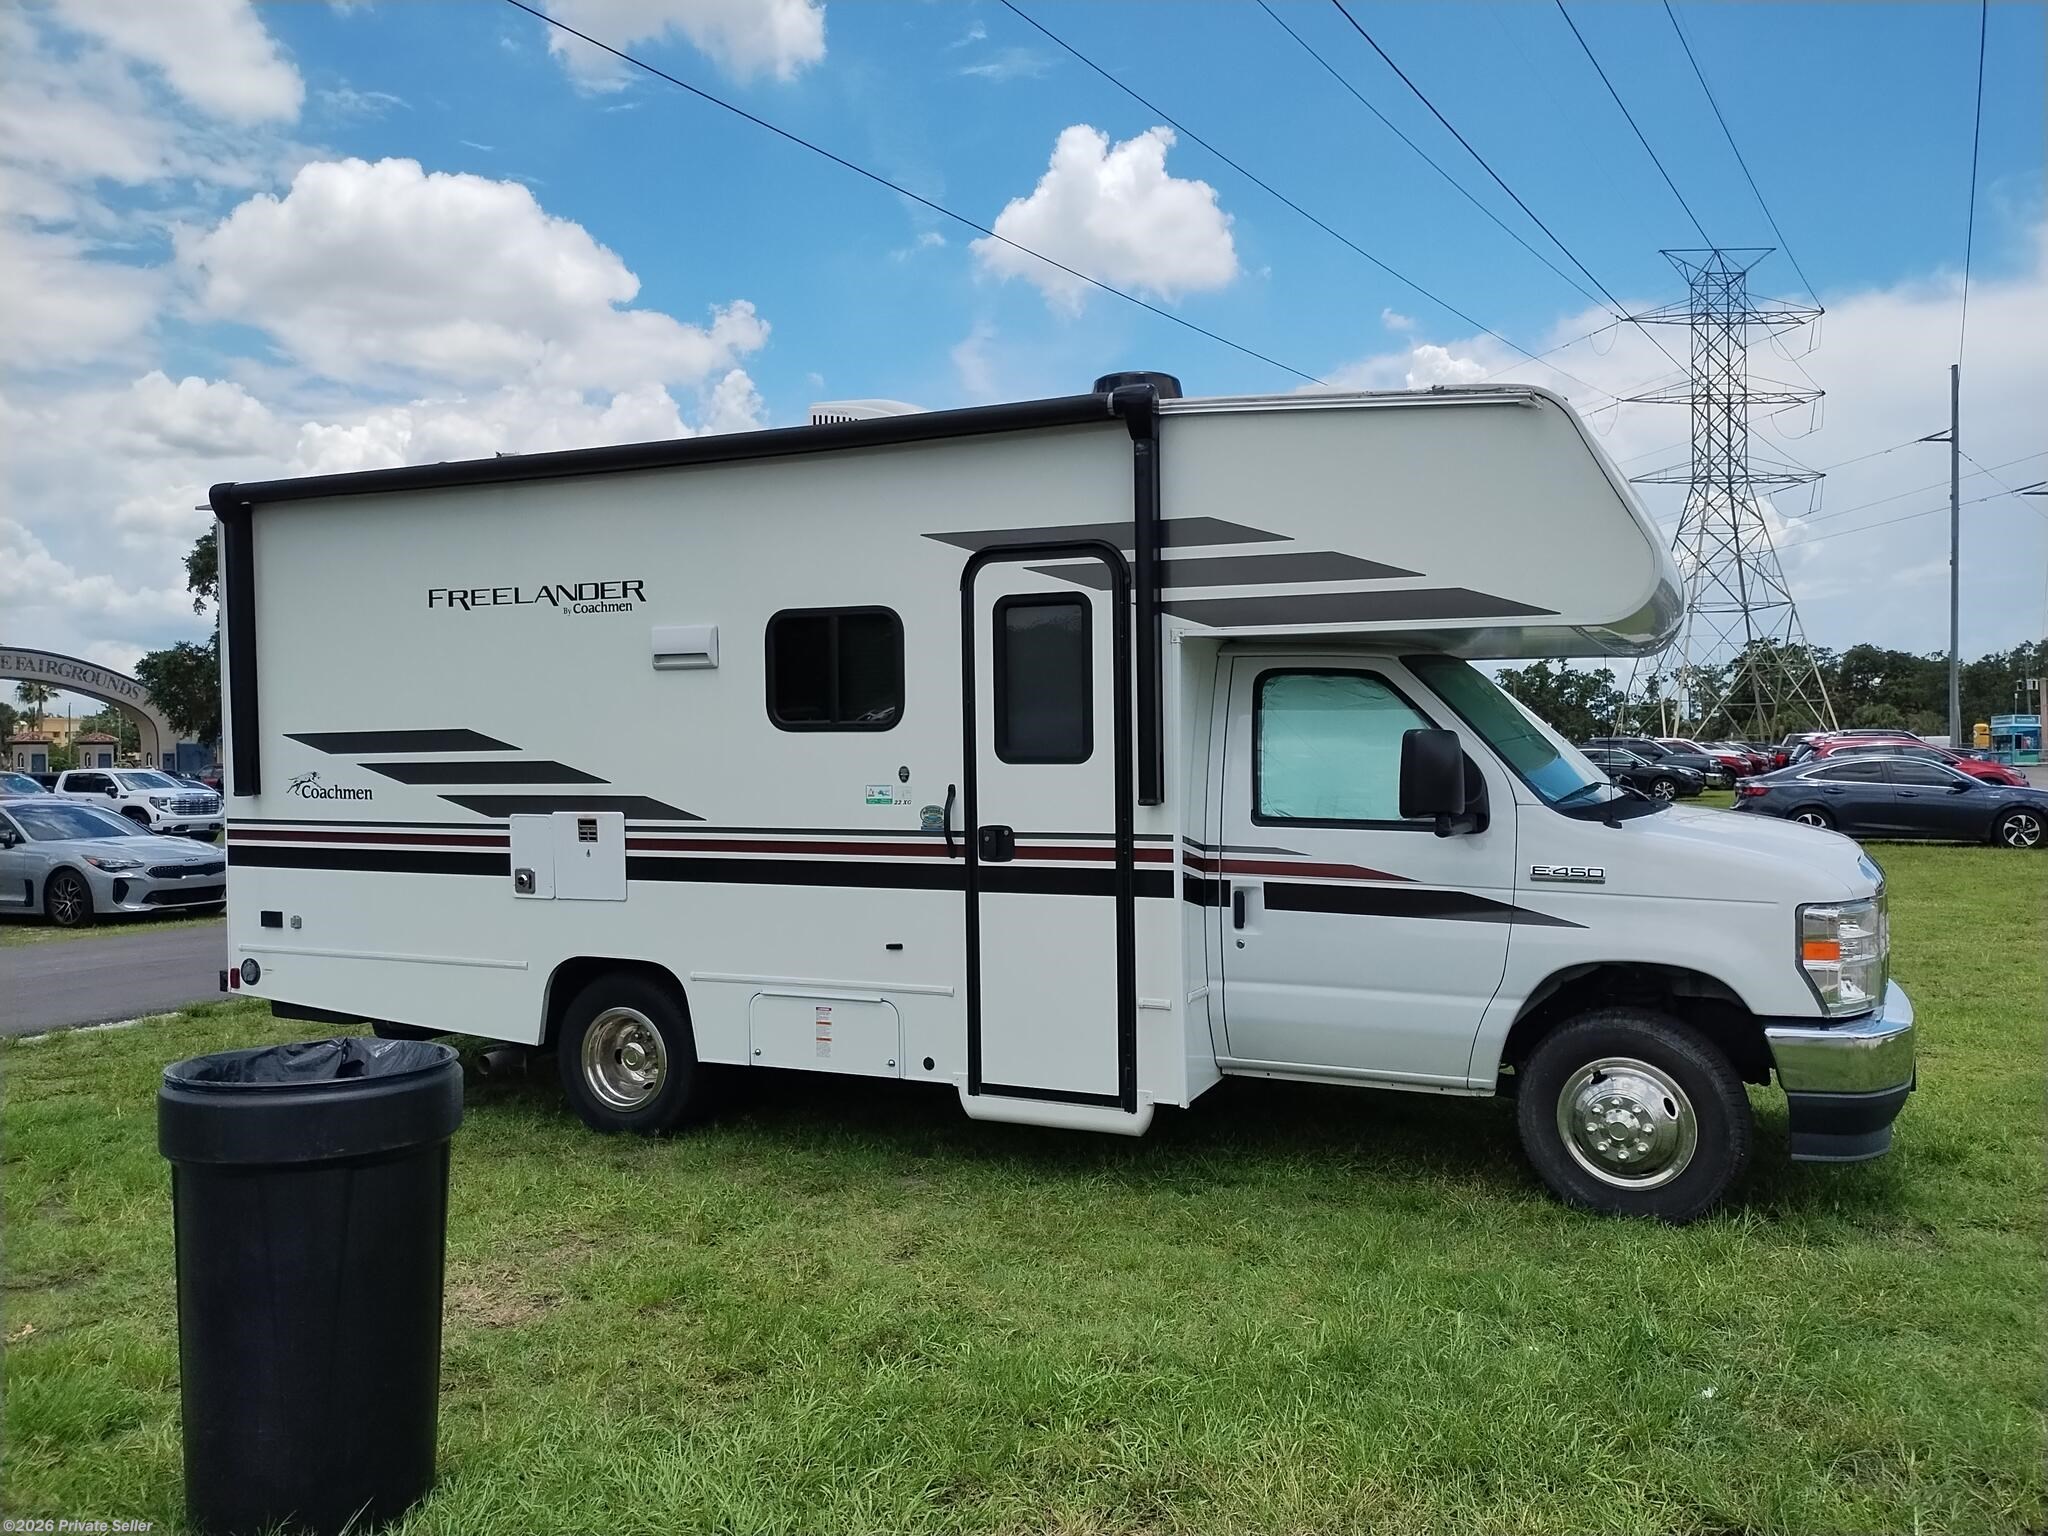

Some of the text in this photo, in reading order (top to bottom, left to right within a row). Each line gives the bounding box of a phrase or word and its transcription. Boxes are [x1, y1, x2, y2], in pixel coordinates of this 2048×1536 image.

[428, 579, 647, 611] FREELANDER
[563, 601, 633, 616] By Coachmen
[15, 656, 141, 700] FAIRGROUNDS
[301, 784, 373, 800] Coachmen
